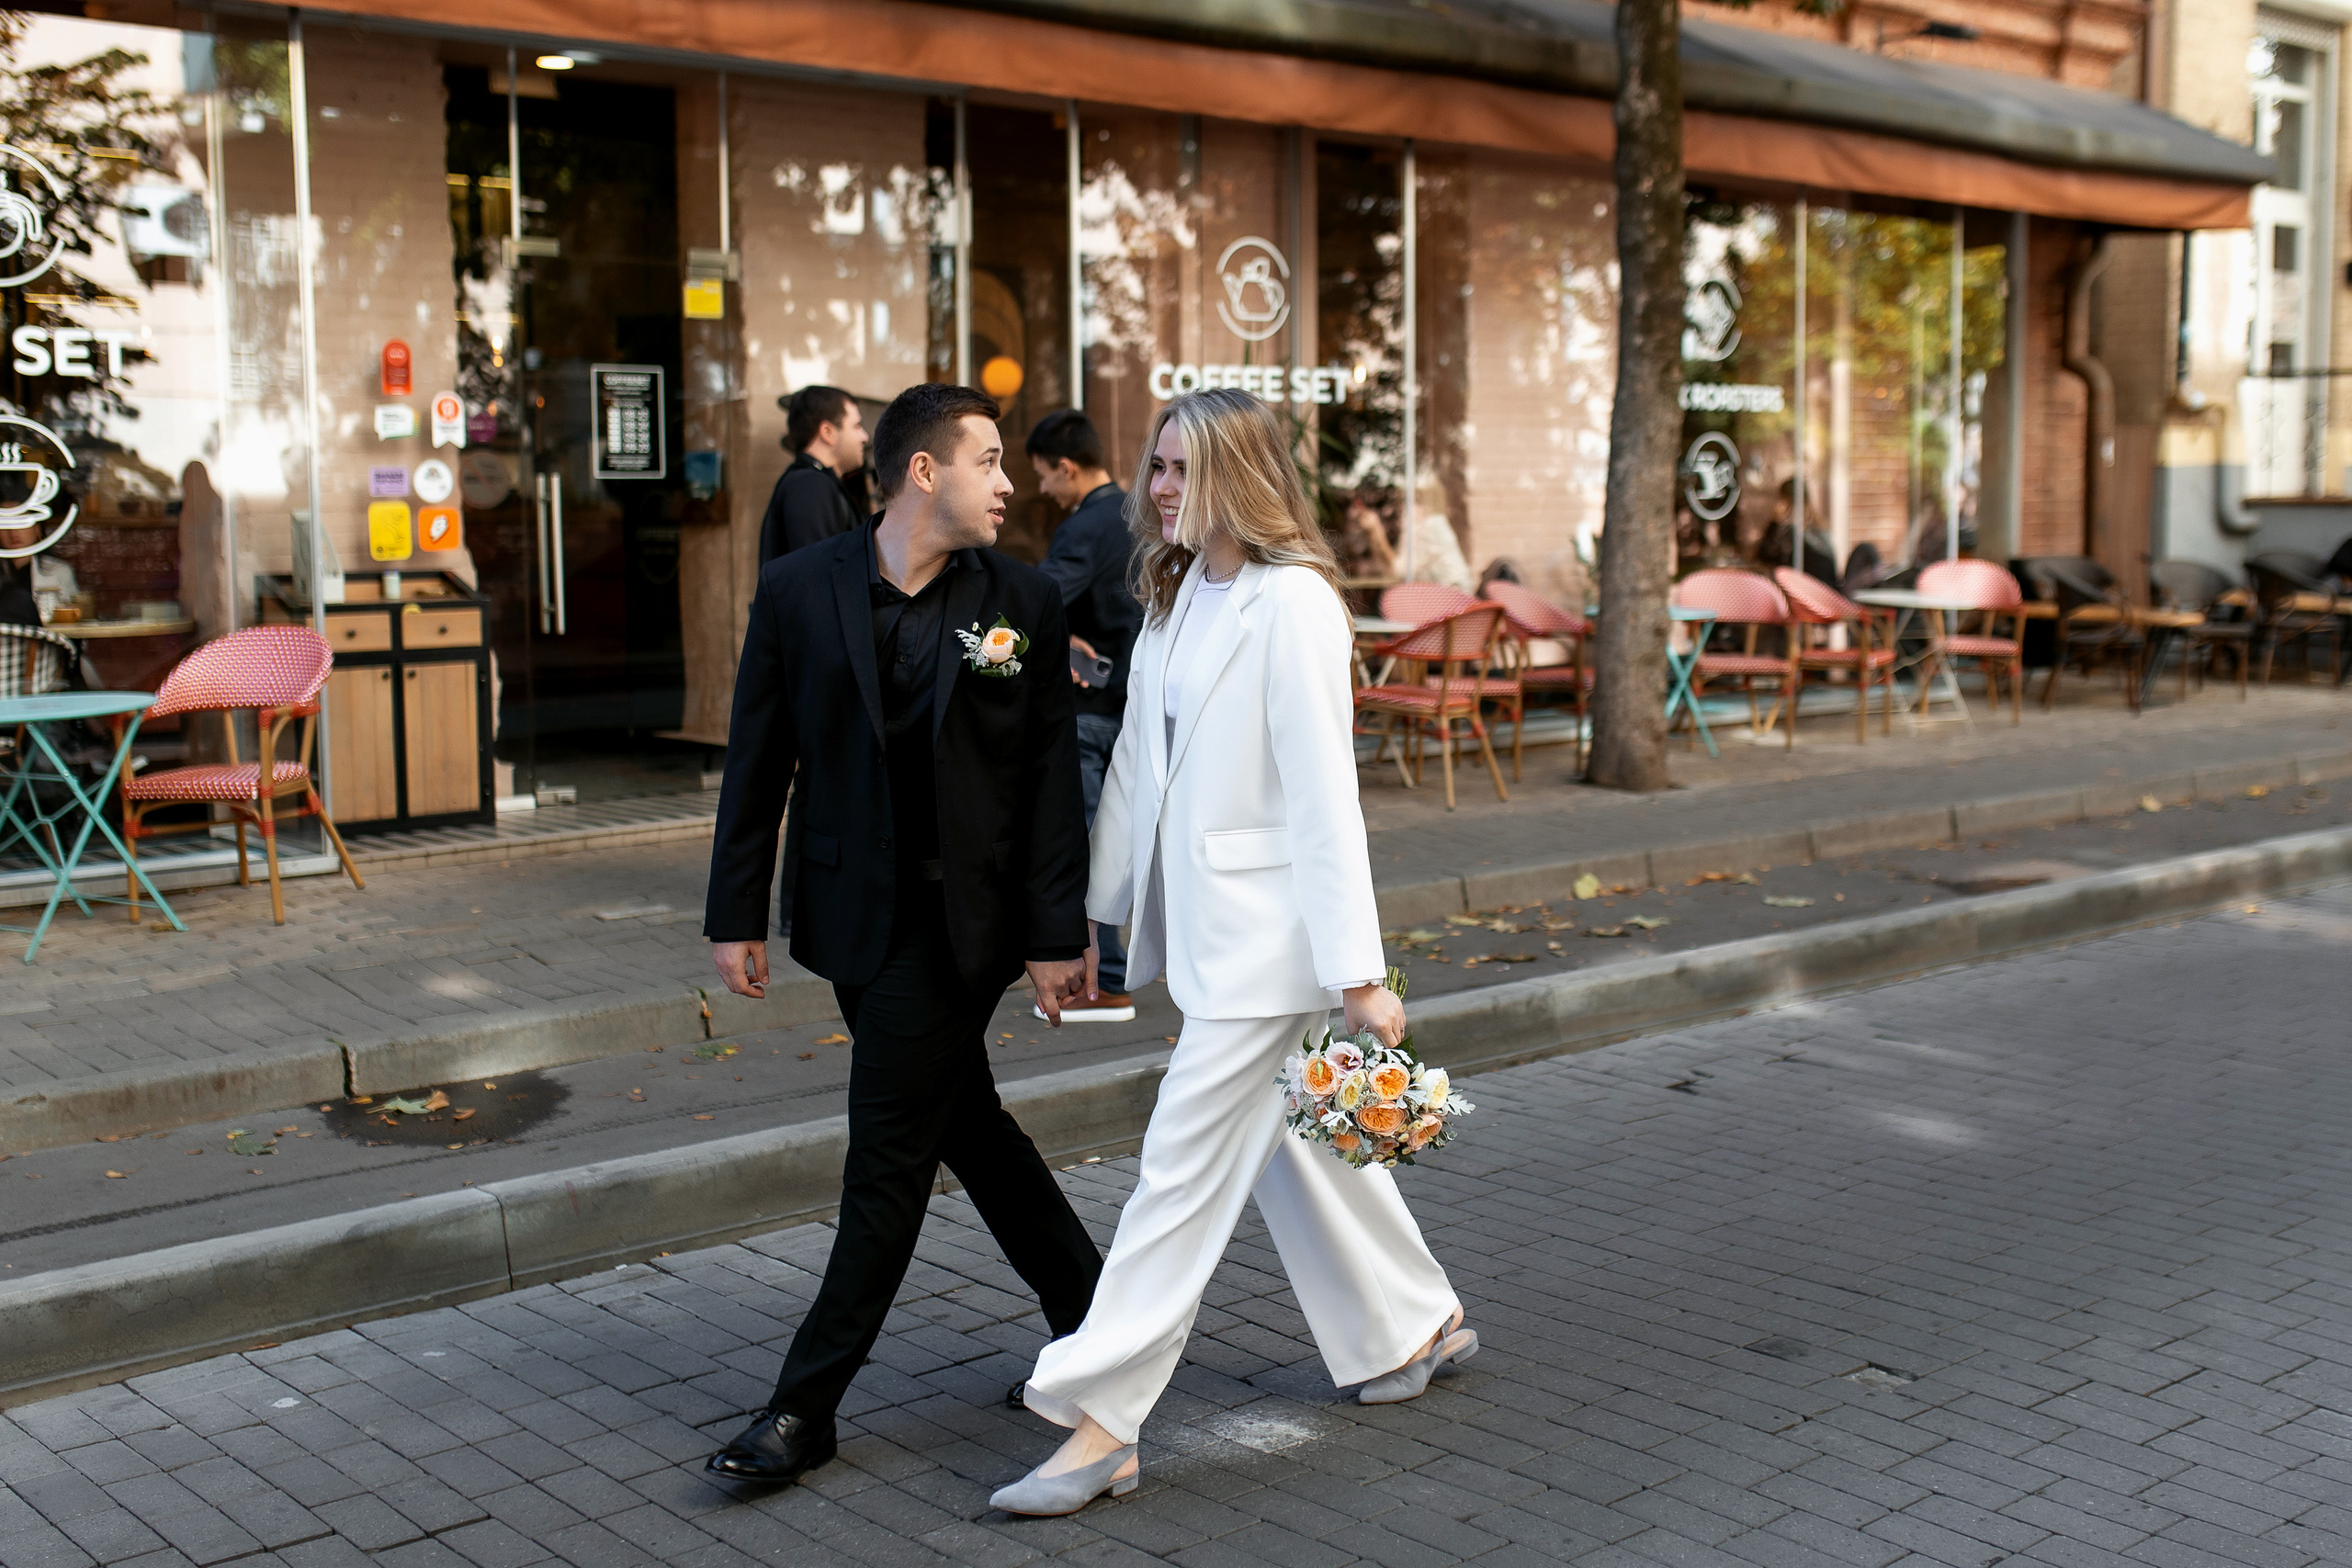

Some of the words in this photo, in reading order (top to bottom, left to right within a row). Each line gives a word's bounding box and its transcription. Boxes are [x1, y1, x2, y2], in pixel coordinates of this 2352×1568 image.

[12, 325, 133, 378] SET
[1149, 363, 1285, 402] COFFEE
[1289, 367, 1349, 404] SET
